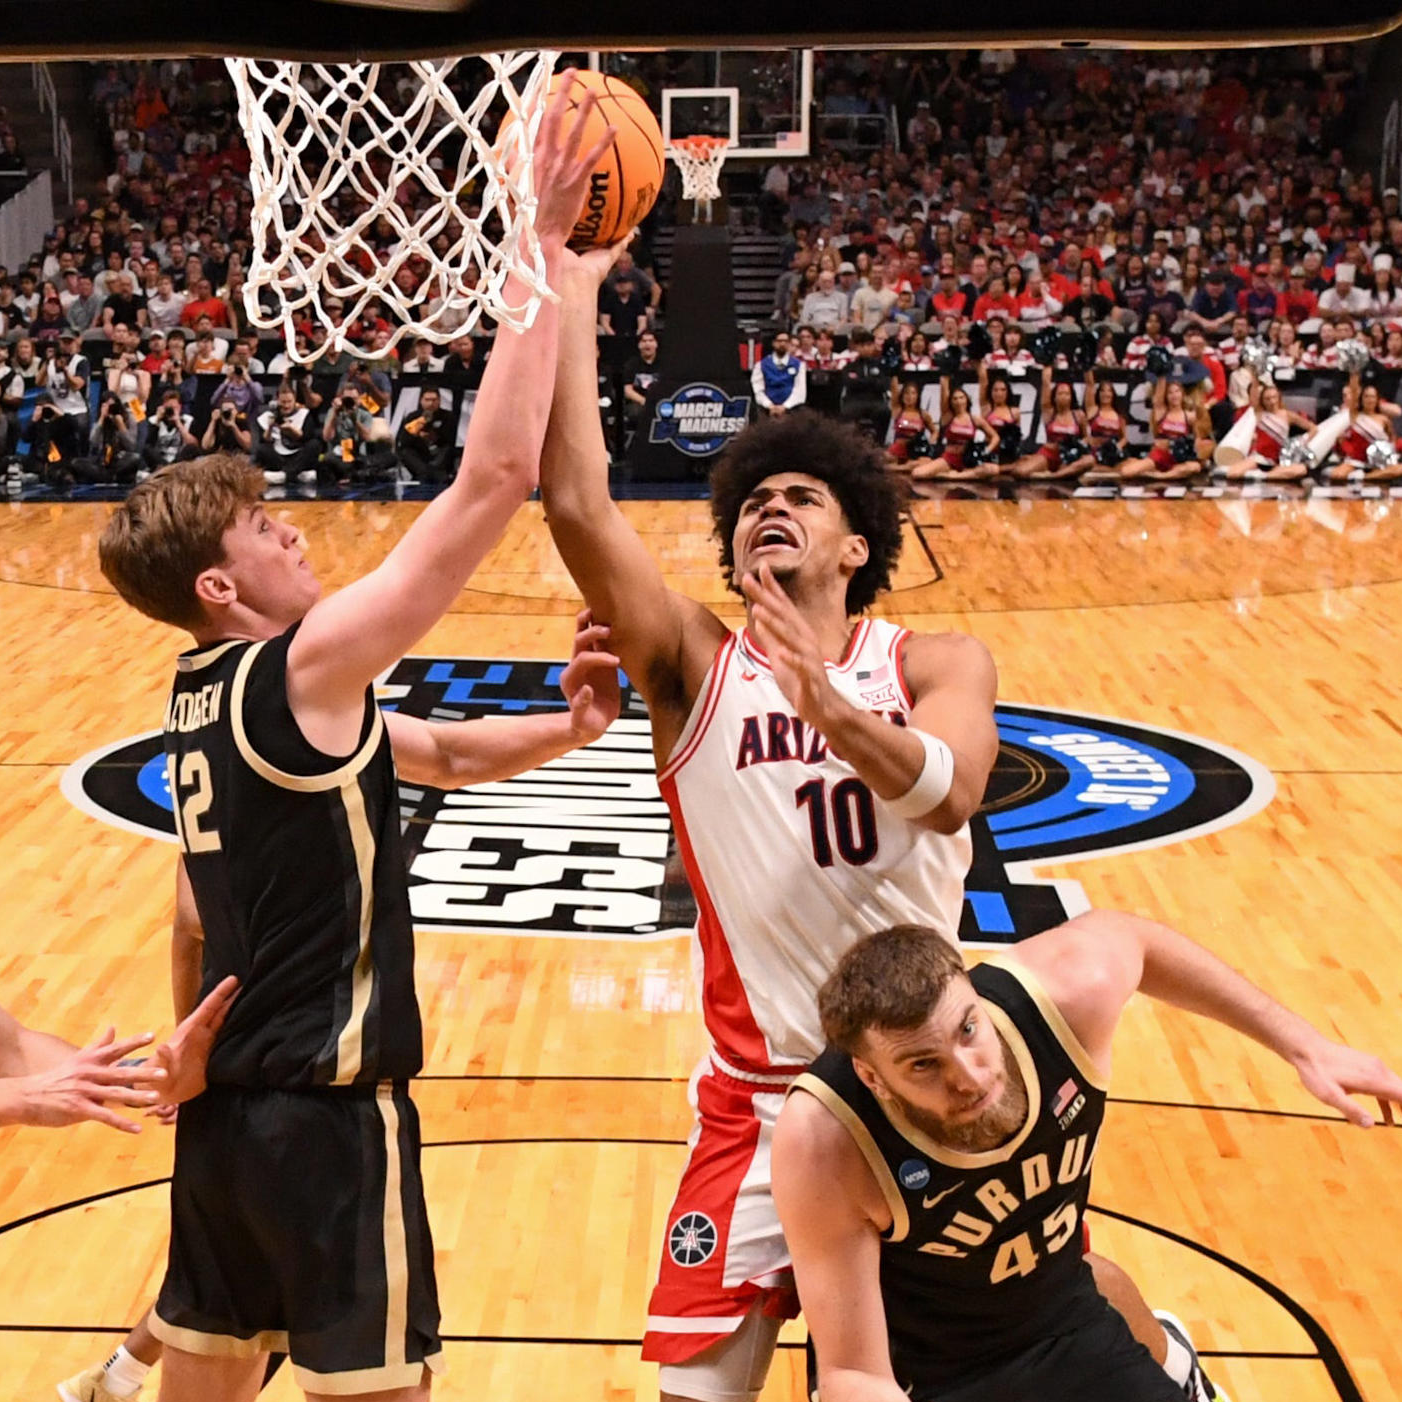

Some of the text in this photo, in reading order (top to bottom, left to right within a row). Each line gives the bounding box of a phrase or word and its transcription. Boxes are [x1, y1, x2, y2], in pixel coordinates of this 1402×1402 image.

[673, 402, 723, 418] MARCH
[678, 417, 746, 433] MADNESS
[167, 750, 223, 854] 12
[1028, 733, 1171, 806] SWEET 16
[795, 776, 878, 868] 10
[989, 1201, 1078, 1285] 45
